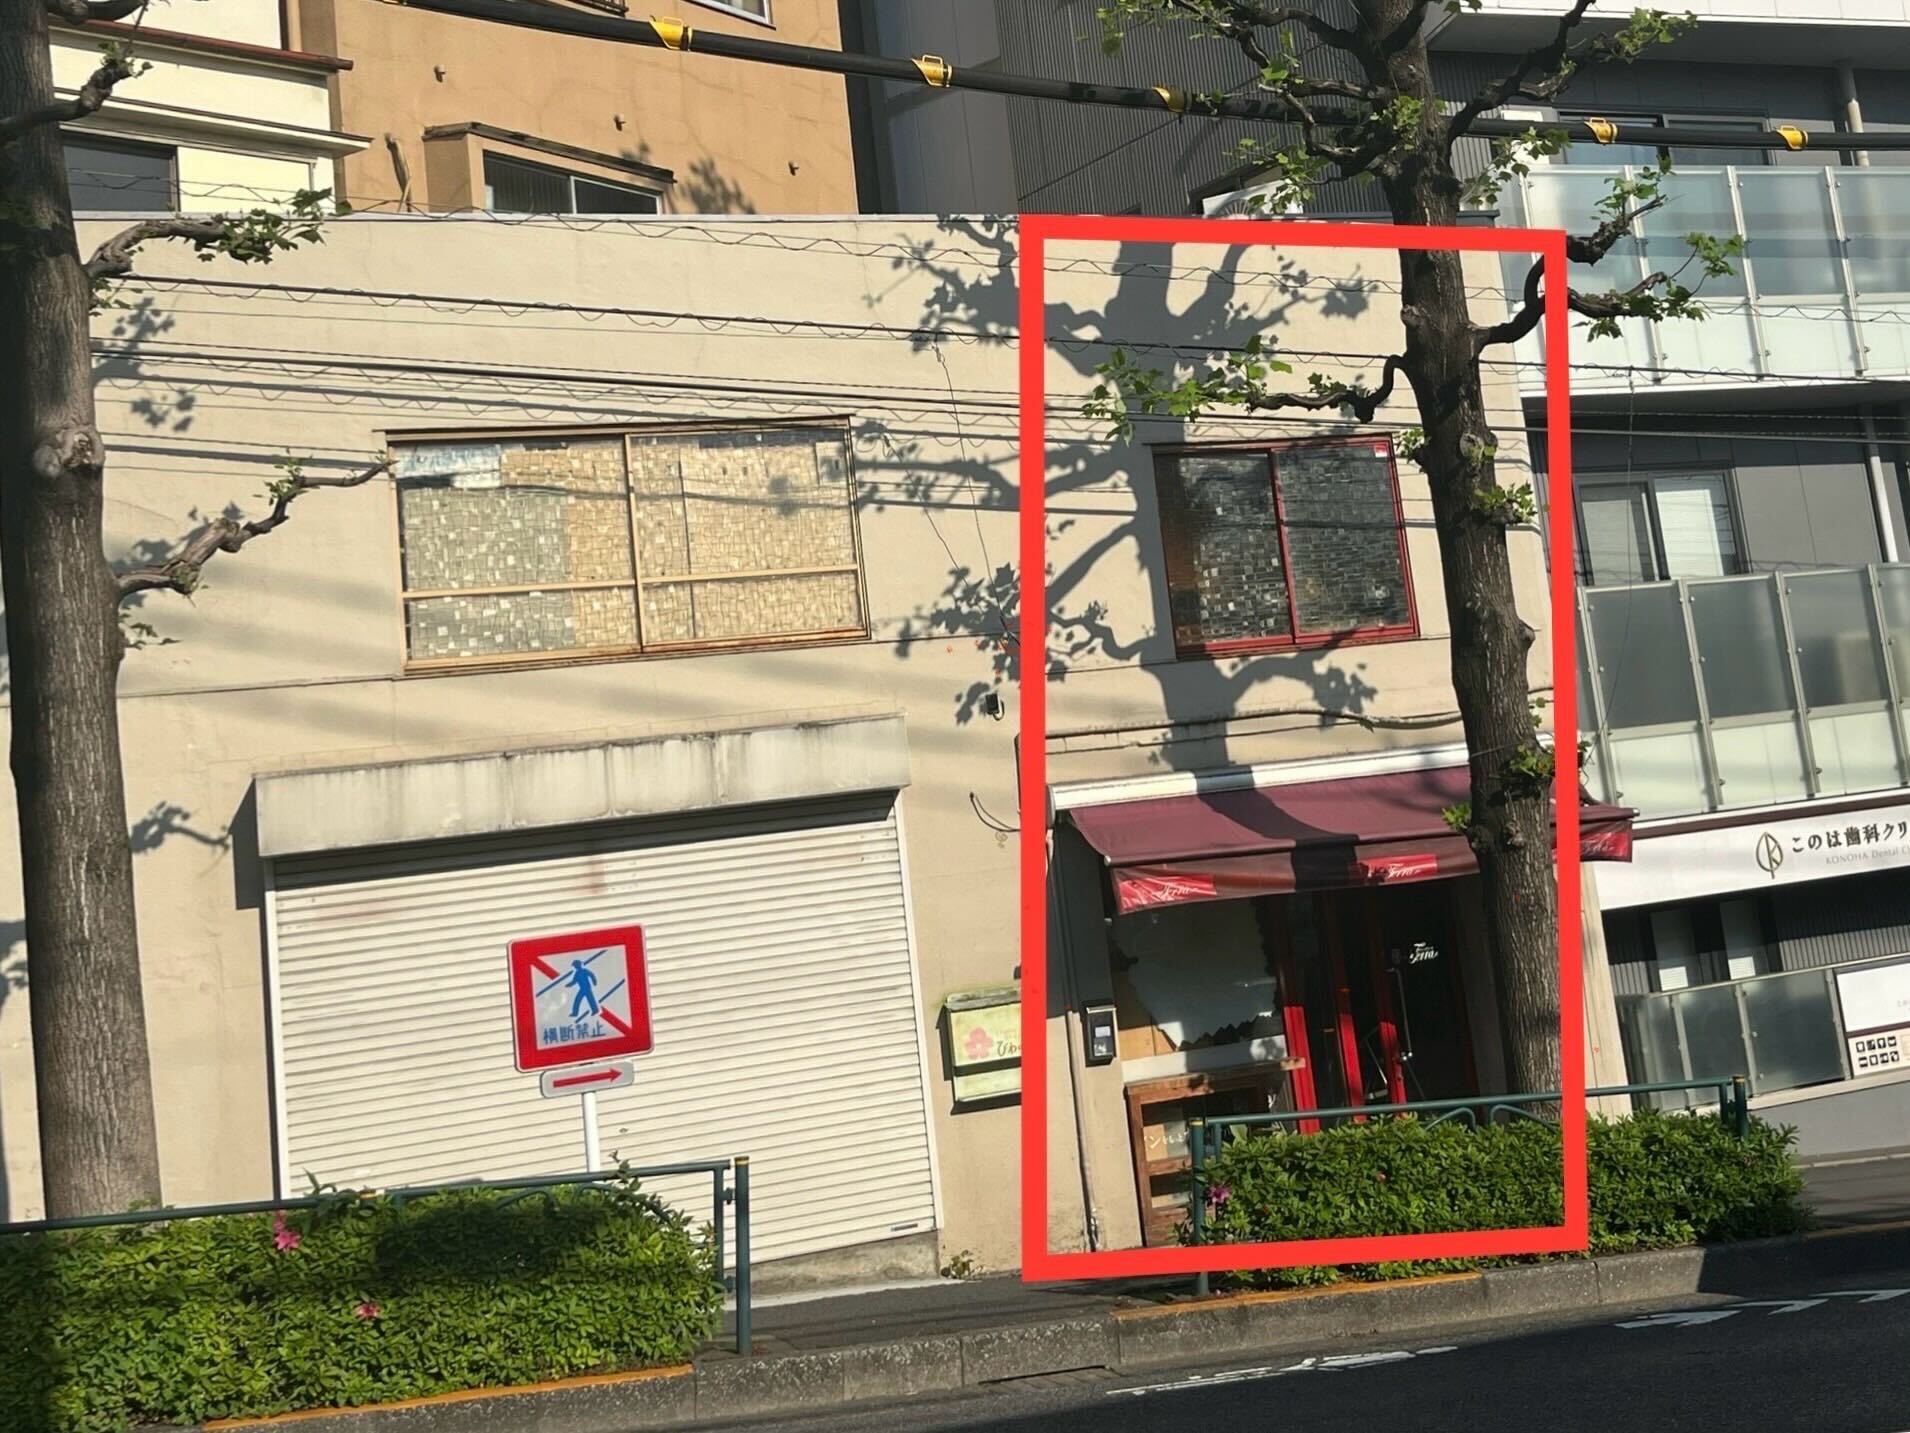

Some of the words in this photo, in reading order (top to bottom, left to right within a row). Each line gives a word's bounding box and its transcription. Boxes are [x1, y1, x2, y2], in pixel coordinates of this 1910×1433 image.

[1792, 821, 1908, 853] このは歯科クリ
[1825, 852, 1869, 865] KONOHA
[1871, 846, 1899, 859] Dental
[543, 1021, 607, 1045] 横断禁止
